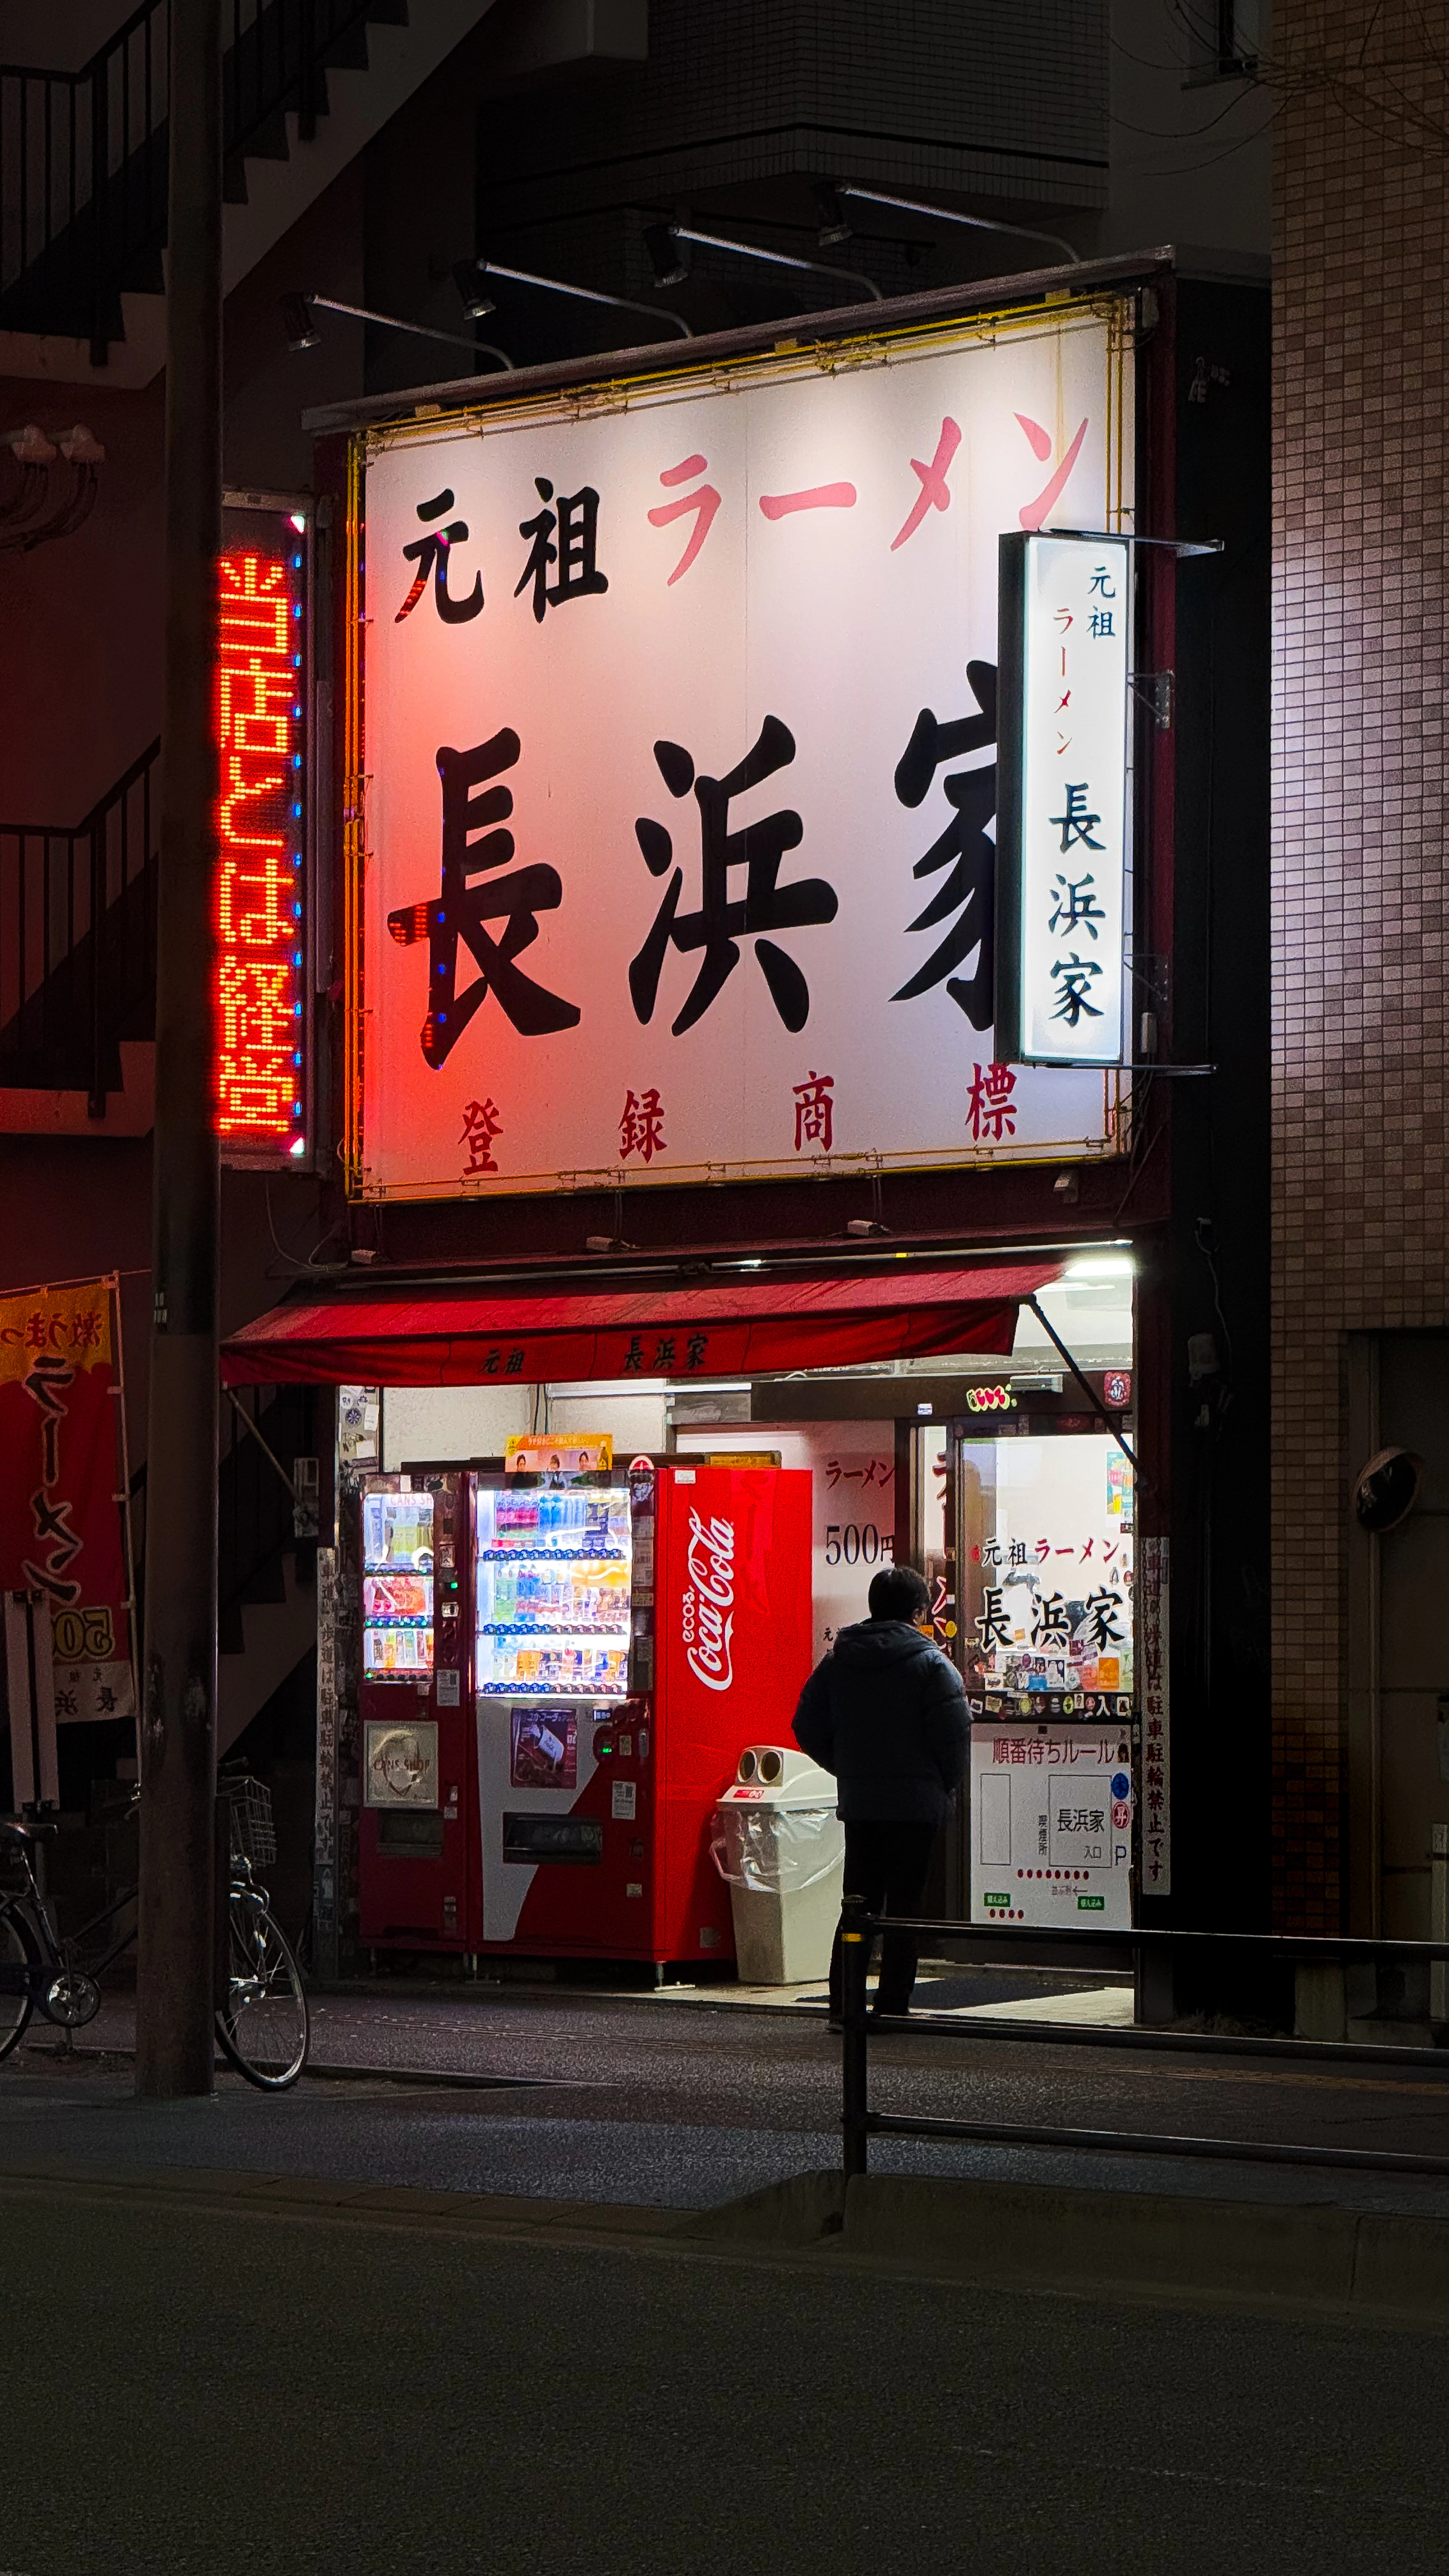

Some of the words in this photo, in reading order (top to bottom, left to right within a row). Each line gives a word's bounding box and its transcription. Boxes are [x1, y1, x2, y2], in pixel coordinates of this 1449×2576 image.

[1087, 566, 1116, 639] 元祖
[1054, 607, 1074, 756] ラーメン
[1048, 782, 1107, 1029] 長浜家
[458, 1063, 1018, 1176] 登録商標
[625, 1333, 709, 1373] 長浜家
[825, 1459, 895, 1490] ラーメン
[825, 1524, 895, 1566] 500円
[687, 1506, 735, 1691] Coca-Cola
[975, 1585, 1126, 1653] 長浜家
[992, 1738, 1115, 1764] 順番待ちルール
[1057, 1809, 1105, 1833] 長浜家
[1084, 1845, 1102, 1859] 入口
[1115, 1845, 1127, 1866] P
